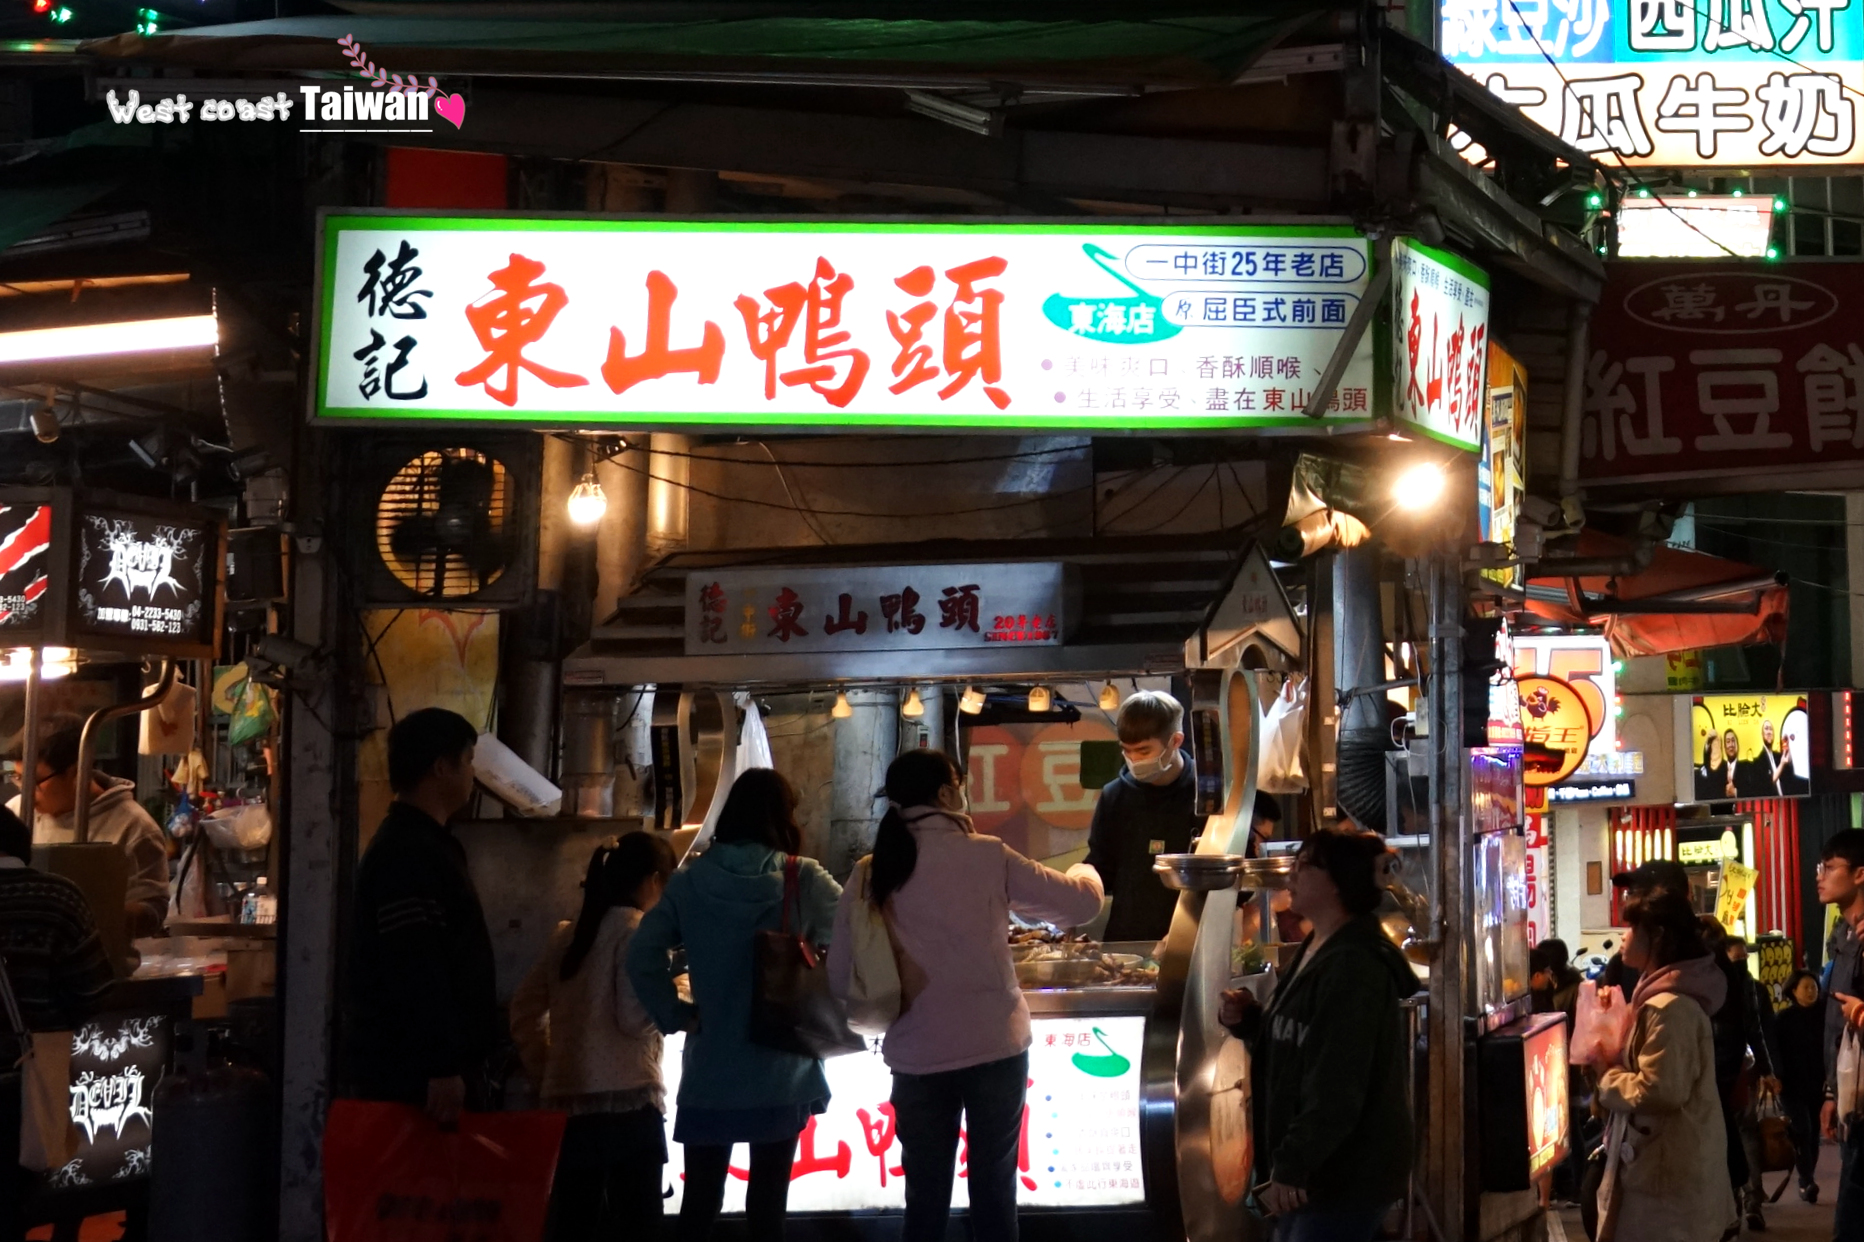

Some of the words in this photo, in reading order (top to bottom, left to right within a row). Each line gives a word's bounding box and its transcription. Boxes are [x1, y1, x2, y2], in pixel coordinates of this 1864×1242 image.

[1146, 251, 1345, 278] 一中街25年老店
[353, 239, 434, 402] 德記
[1068, 302, 1155, 336] 東海店
[1651, 283, 1816, 322] 萬丹
[455, 252, 1012, 409] 東山鴨頭
[1407, 286, 1485, 440] 東山鴨頭
[768, 584, 981, 642] 東山鴨頭
[1045, 1033, 1091, 1048] 東海店
